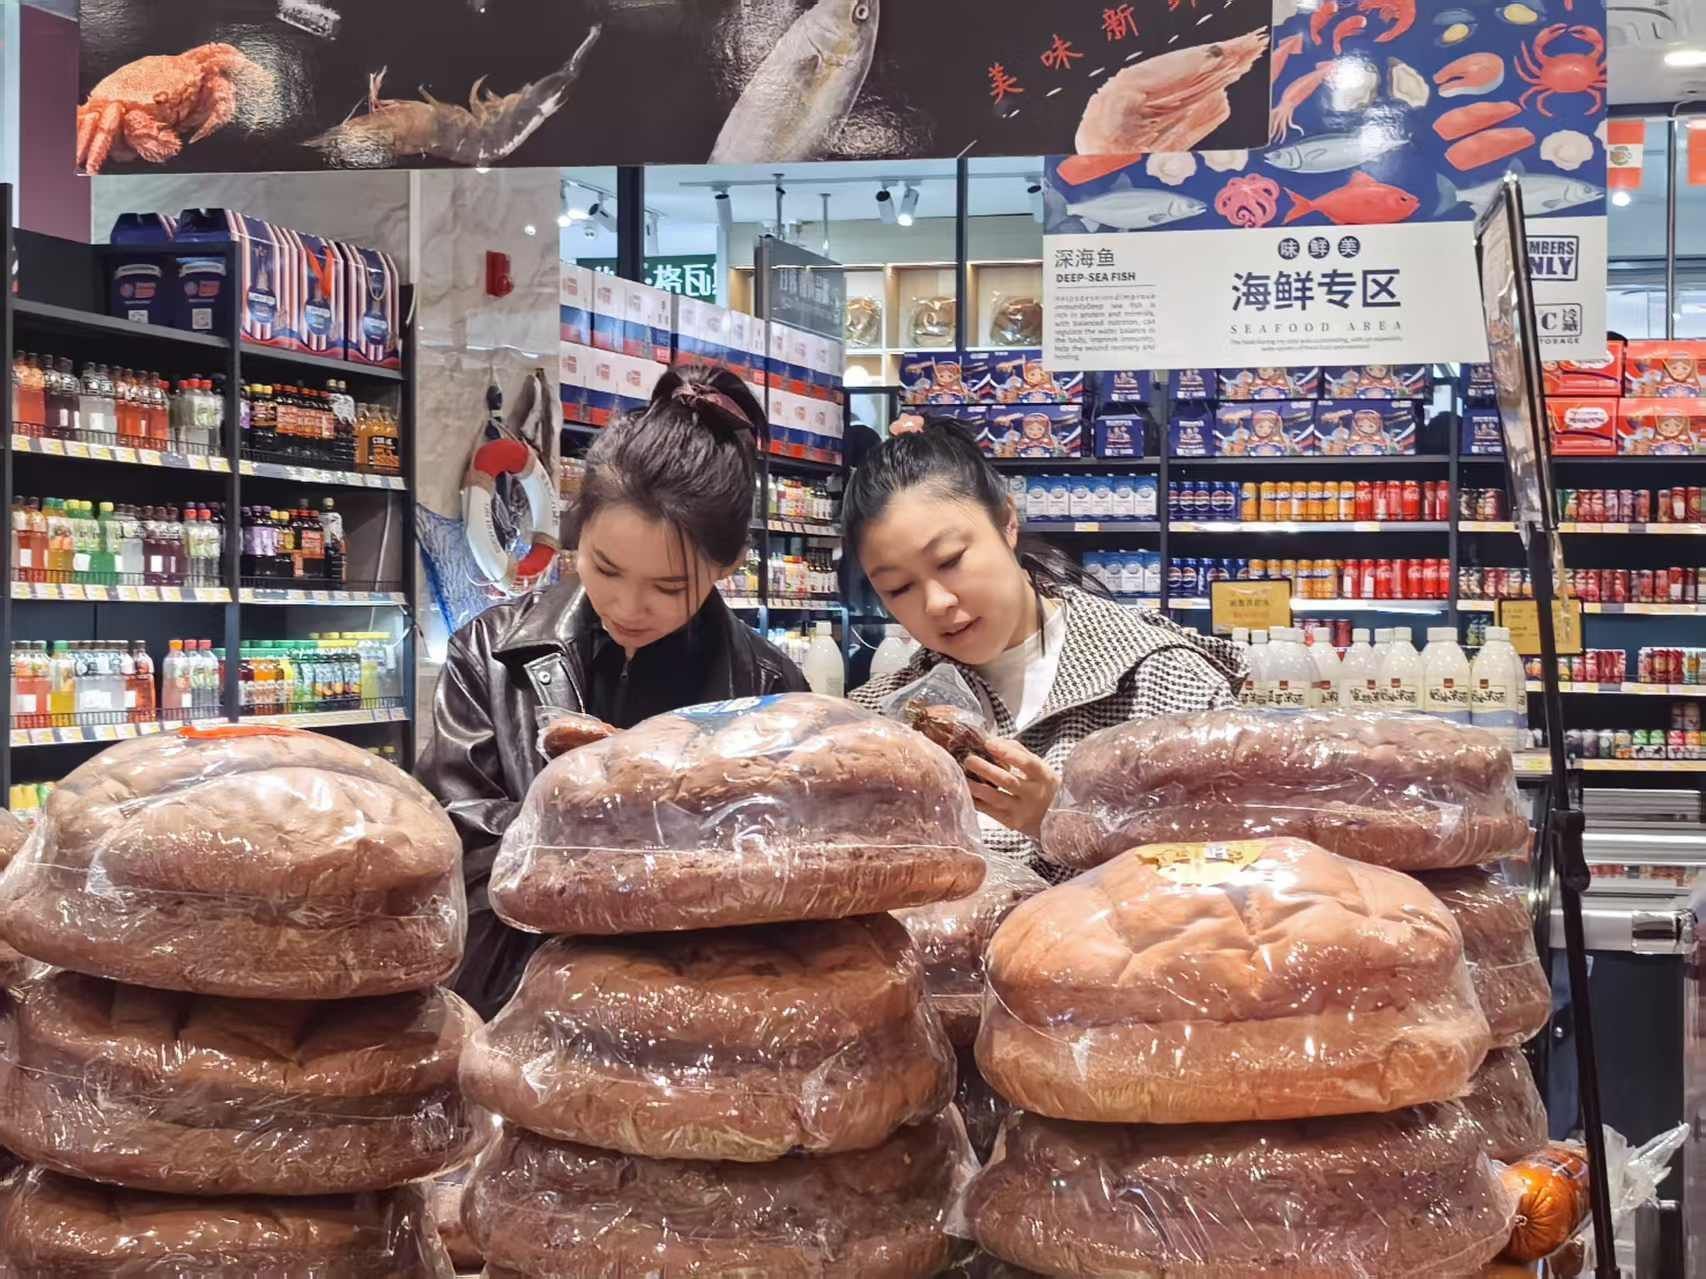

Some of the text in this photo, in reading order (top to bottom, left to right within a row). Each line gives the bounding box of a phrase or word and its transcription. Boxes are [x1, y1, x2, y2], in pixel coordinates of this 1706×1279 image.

[1055, 248, 1115, 268] 深海鱼
[1111, 272, 1136, 281] FISH
[1231, 268, 1401, 311] 海鲜专区
[1230, 318, 1402, 334] SEAFOOD AREA
